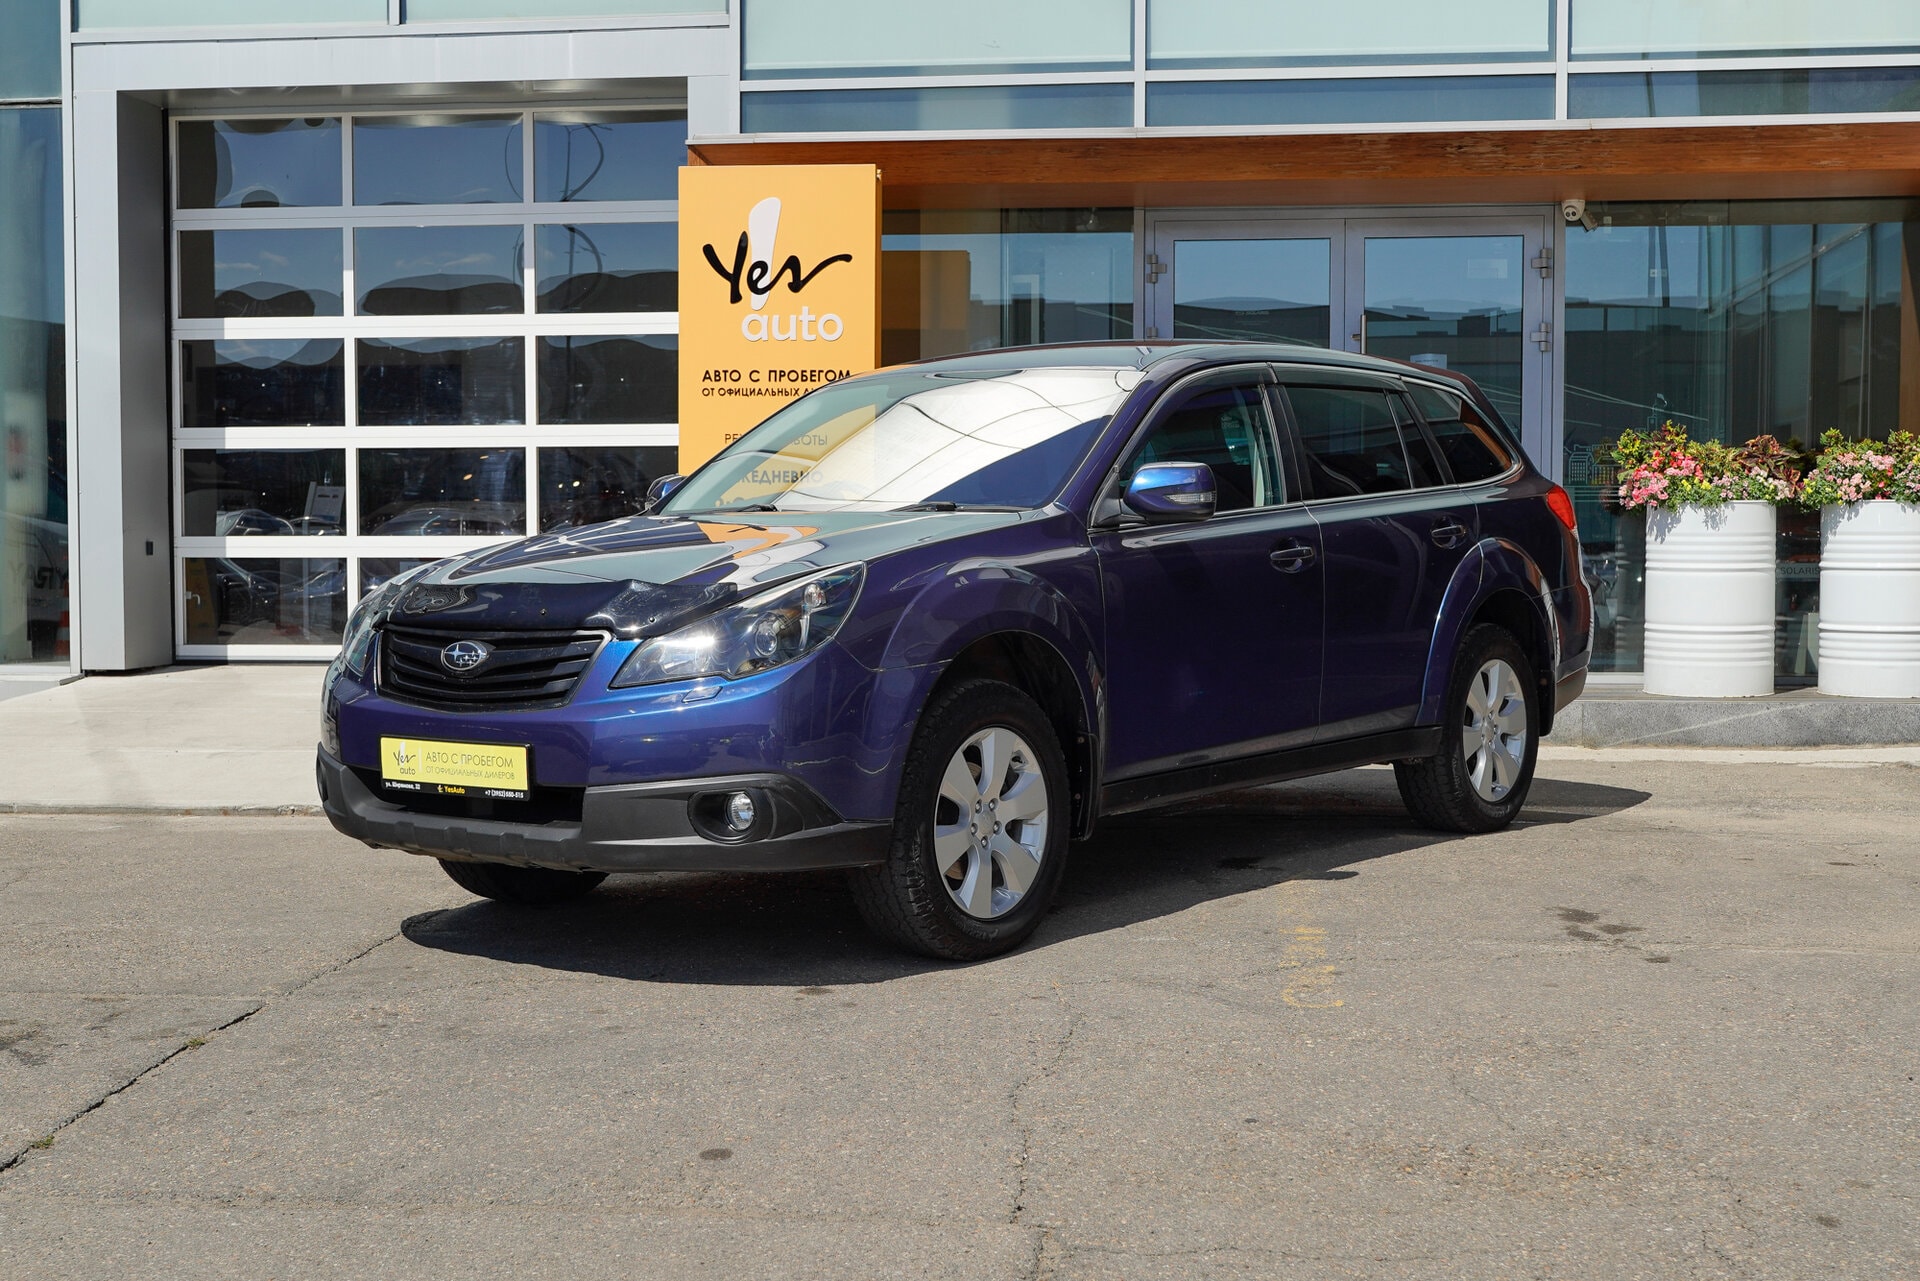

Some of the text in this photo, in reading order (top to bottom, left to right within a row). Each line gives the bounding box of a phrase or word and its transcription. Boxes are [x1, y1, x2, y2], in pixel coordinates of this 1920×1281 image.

[702, 231, 853, 304] Yes
[741, 306, 843, 341] auto
[702, 370, 851, 382] АВТО С ПРОБЕГОМ
[702, 388, 715, 396] ОТ
[718, 388, 800, 398] ОФИЦИАЛЬНЫХ
[1780, 566, 1820, 575] SOLARIS
[393, 749, 416, 766] Yes
[426, 752, 514, 768] АВТО С ПРОБЕГОМ
[400, 767, 416, 775] auto
[484, 771, 515, 780] ДИЛЕРОВ
